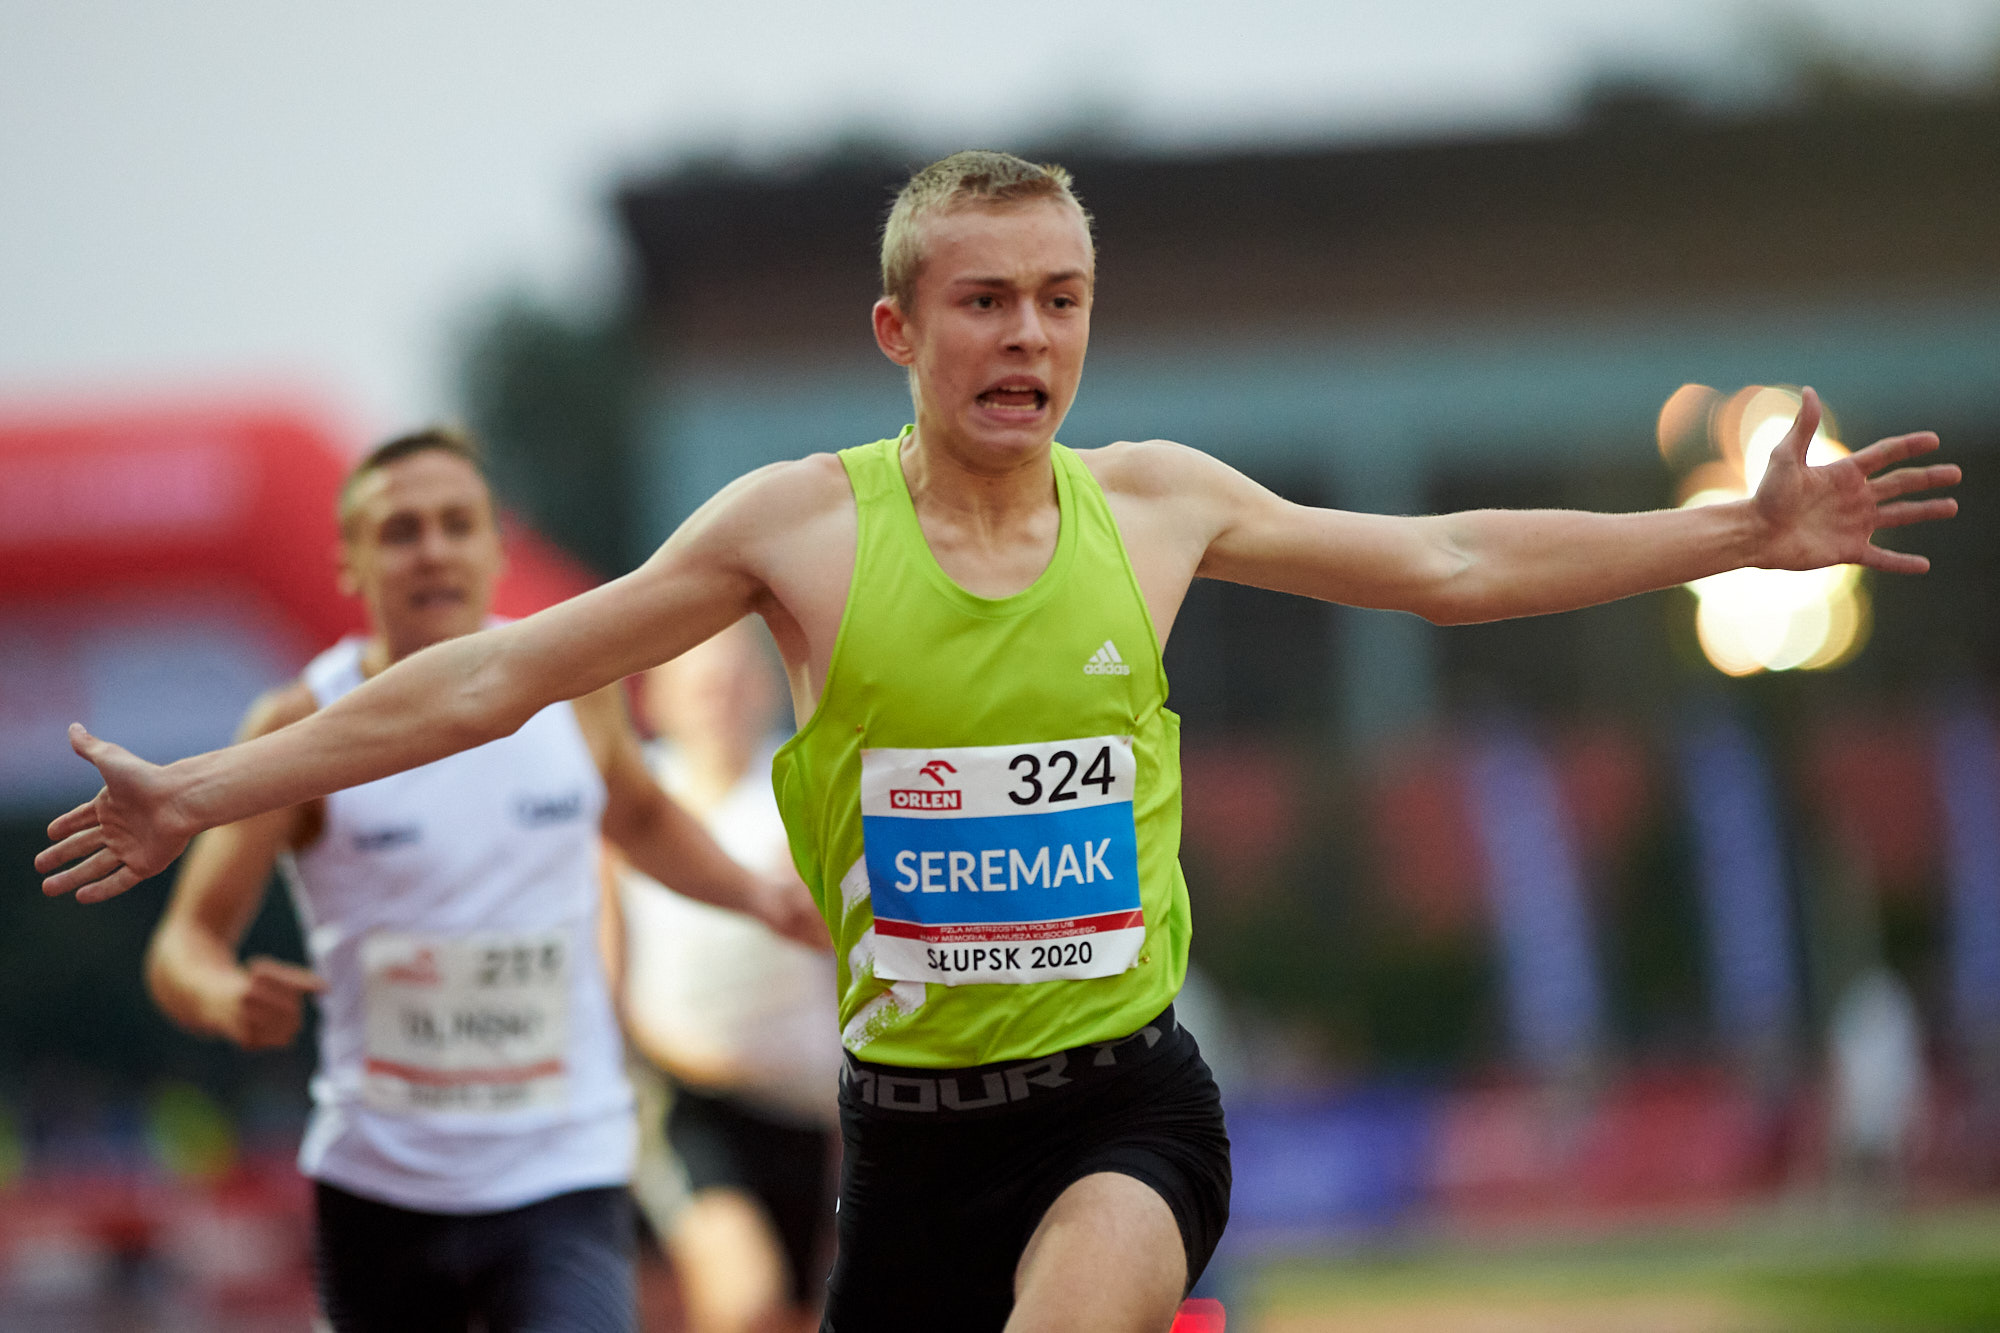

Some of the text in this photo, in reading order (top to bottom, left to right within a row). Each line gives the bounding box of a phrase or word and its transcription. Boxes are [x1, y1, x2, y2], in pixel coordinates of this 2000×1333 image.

[1083, 662, 1130, 676] adidas
[1008, 745, 1115, 806] 324
[893, 791, 958, 809] ORLEN
[894, 837, 1114, 893] SEREMAK
[965, 924, 1027, 934] MISTRZOSTWA
[1028, 923, 1059, 932] POLSKI
[927, 941, 1092, 972] SŁUPSK 2020
